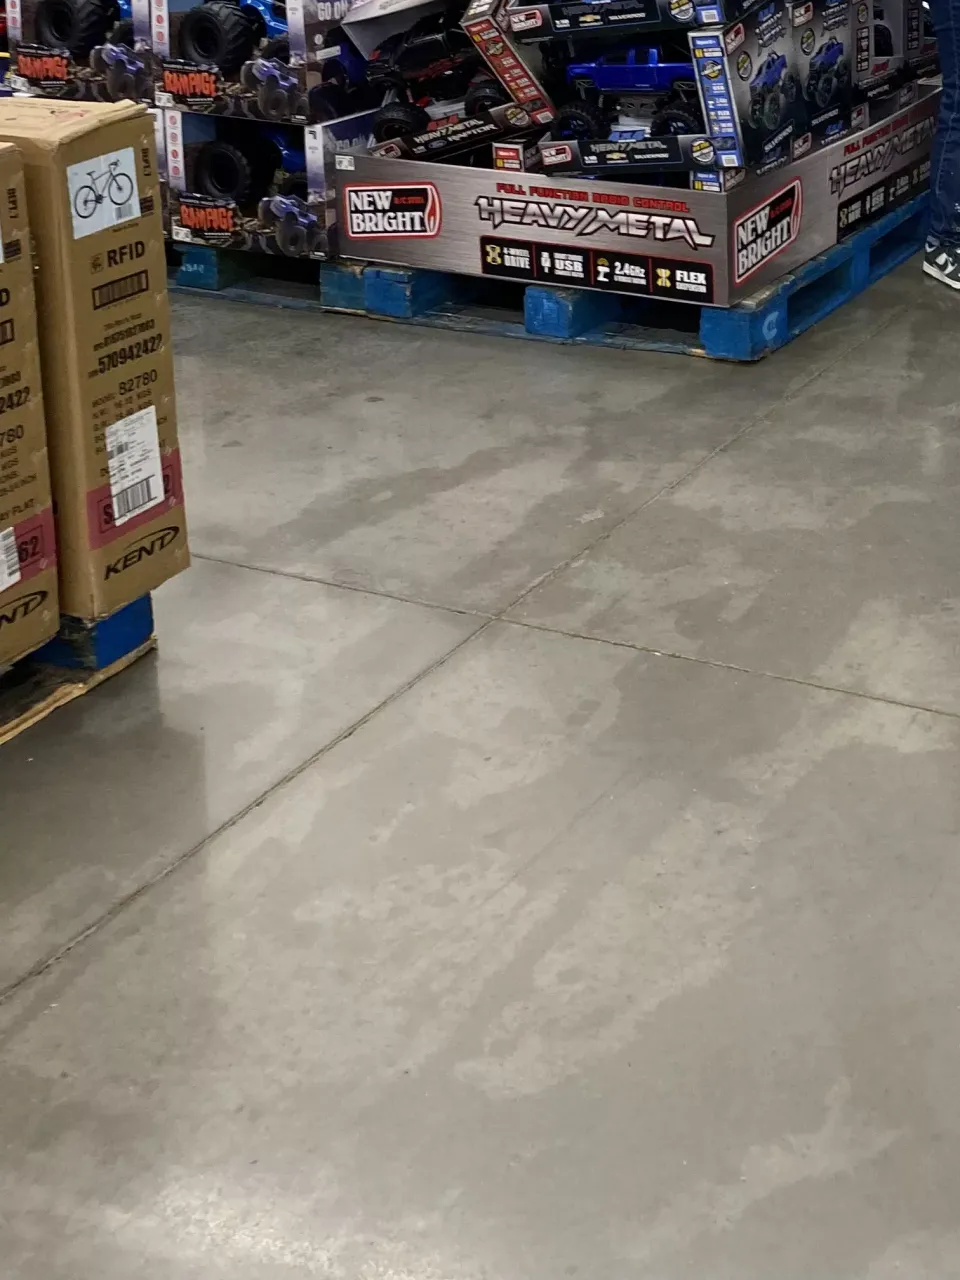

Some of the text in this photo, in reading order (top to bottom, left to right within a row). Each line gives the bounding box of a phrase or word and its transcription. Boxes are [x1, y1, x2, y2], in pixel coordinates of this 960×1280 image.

[317, 1, 331, 21] GO
[164, 71, 217, 97] RAMPAGE
[413, 128, 447, 144] HEAVY
[829, 142, 889, 198] HEAVY
[350, 190, 393, 211] NEW
[496, 182, 690, 212] FULL FUNCTION RADIO CONTROL
[179, 204, 234, 232] RAMPAGE
[352, 211, 425, 233] BRIGHT
[473, 196, 717, 251] HEAVY METAL
[736, 205, 771, 250] NEW
[106, 240, 145, 268] RFID
[737, 216, 791, 276] BRIGHT
[503, 255, 530, 269] DRIVE
[554, 259, 584, 272] USB
[676, 269, 707, 285] FLEX
[118, 368, 158, 396] 82780
[104, 531, 172, 581] KENT
